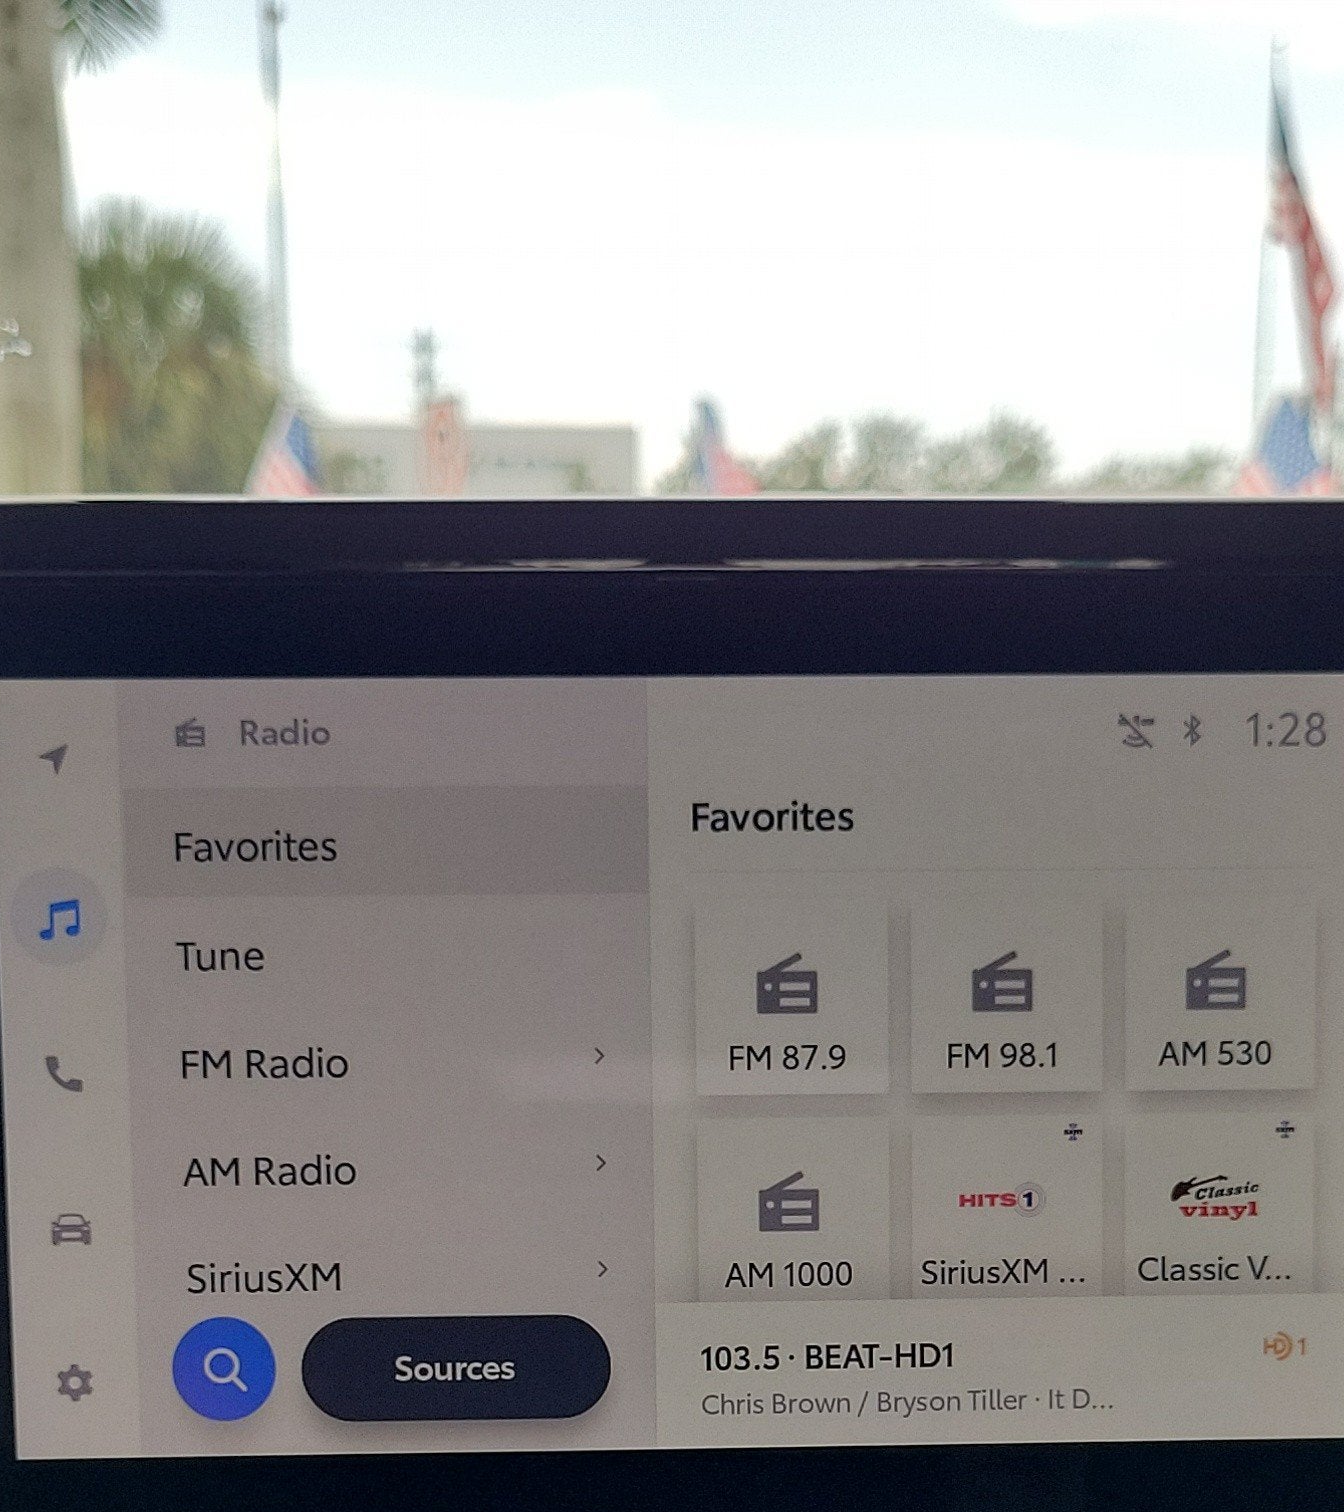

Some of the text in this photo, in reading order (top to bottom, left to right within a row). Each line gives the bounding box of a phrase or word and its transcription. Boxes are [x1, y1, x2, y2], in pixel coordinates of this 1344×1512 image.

[239, 717, 331, 746] Radio
[1246, 711, 1327, 748] 1:28
[691, 799, 854, 833] Favorites
[174, 829, 338, 863] Favorites
[175, 941, 265, 972] Tune
[181, 1046, 349, 1080] FM Radio
[729, 1044, 847, 1071] FM 87.9
[947, 1042, 1057, 1069] FM 98.1
[1158, 1039, 1272, 1067] AM 530
[183, 1153, 357, 1187] AM Radio
[958, 1192, 1017, 1208] HITS
[1194, 1181, 1260, 1200] Classic
[1178, 1201, 1259, 1220] vinyl
[187, 1262, 341, 1295] SiriusXM
[724, 1261, 853, 1288] AM 1000
[921, 1258, 1048, 1285] SiriusXM
[1137, 1255, 1291, 1282] Classic V...
[395, 1355, 516, 1382] Sources
[701, 1345, 780, 1372] 103.5
[805, 1342, 953, 1370] BEAT-HD1
[701, 1392, 765, 1416] Chris
[772, 1392, 851, 1415] Brown
[877, 1391, 961, 1419] Bryson
[966, 1388, 1028, 1412] Tiller
[1048, 1388, 1065, 1410] It
[1072, 1387, 1114, 1410] D...
